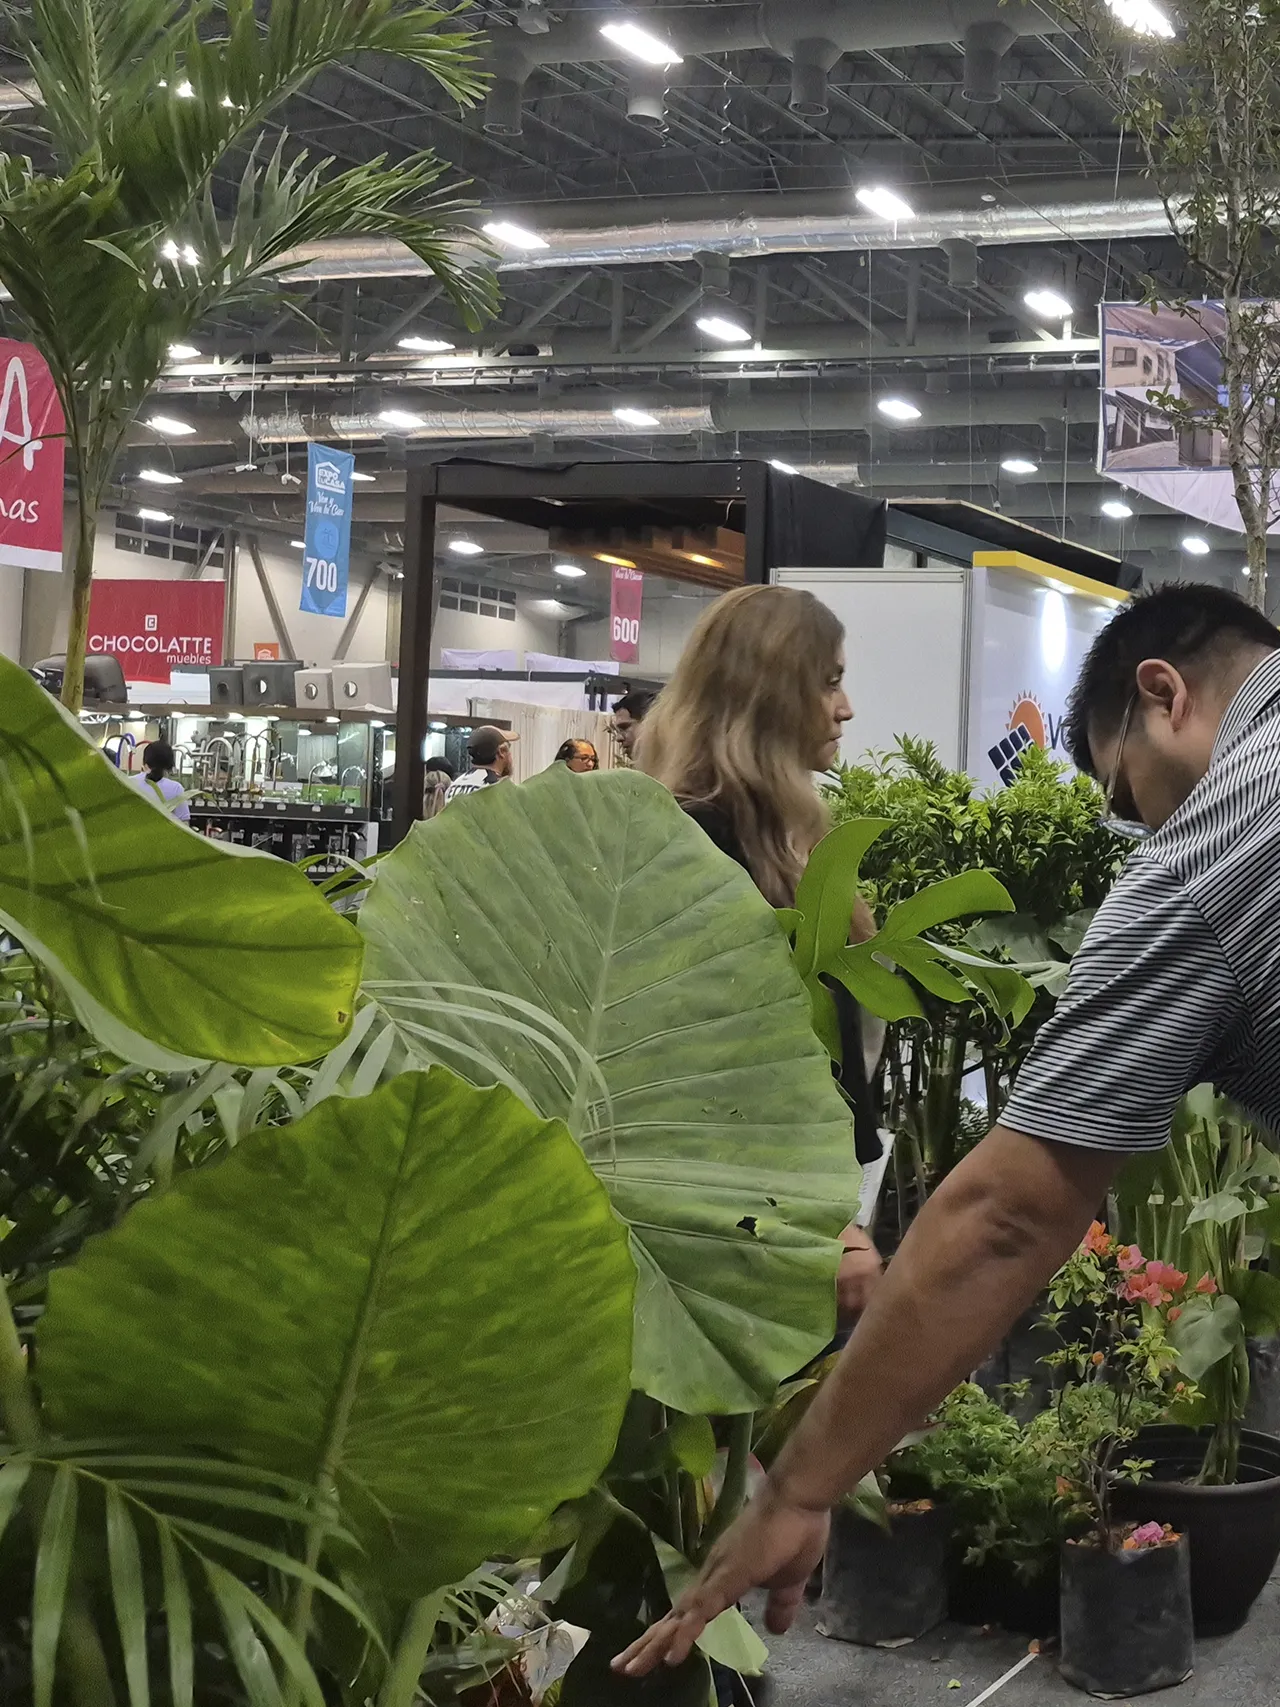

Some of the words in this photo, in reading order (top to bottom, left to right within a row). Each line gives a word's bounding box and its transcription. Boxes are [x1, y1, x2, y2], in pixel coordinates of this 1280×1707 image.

[306, 557, 338, 593] 700
[613, 616, 639, 645] 600
[89, 635, 212, 654] CHOCOLATTE
[166, 653, 212, 665] muebles
